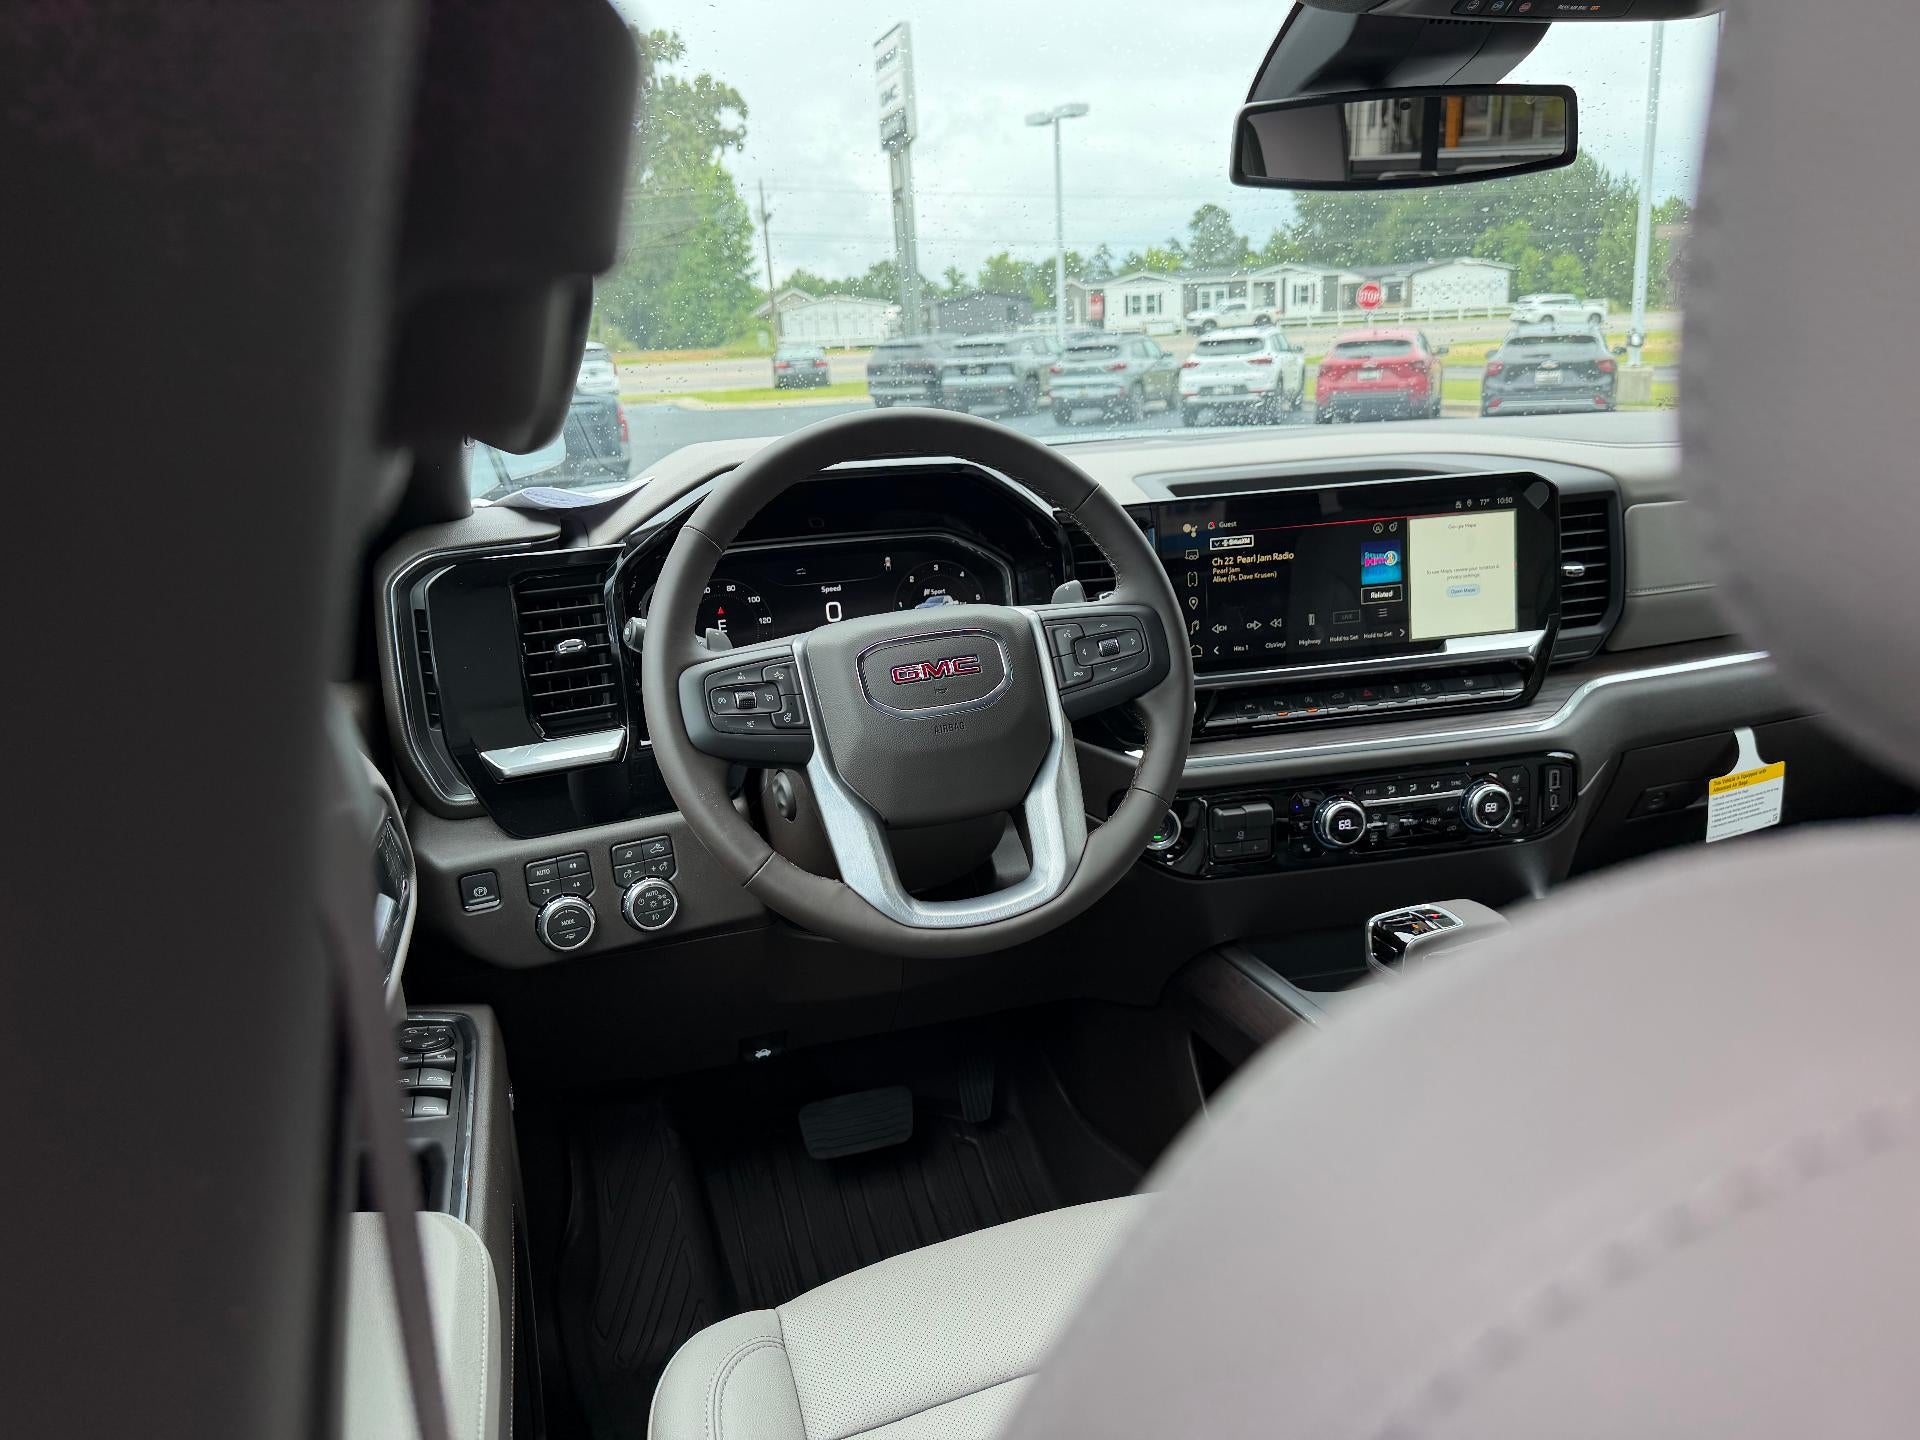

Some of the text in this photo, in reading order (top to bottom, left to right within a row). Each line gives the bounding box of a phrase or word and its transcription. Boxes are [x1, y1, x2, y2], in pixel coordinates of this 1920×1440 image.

[1359, 290, 1380, 303] STOP
[1211, 552, 1294, 566] Ch 22 Pearl Jam Radio
[959, 570, 965, 578] 4
[1212, 566, 1241, 575] Pearl Jam
[1212, 575, 1228, 583] Alive
[1238, 573, 1254, 581] Dave
[1254, 571, 1278, 580] Krusen)
[726, 584, 736, 592] 80
[820, 584, 842, 594] Speed
[747, 595, 761, 603] 100
[1370, 590, 1394, 599] Related
[825, 601, 843, 623] 0
[758, 616, 772, 624] 120
[890, 654, 982, 685] GMC
[933, 721, 966, 735] AIRBAG
[536, 868, 551, 876] AUTO
[645, 889, 659, 898] AUTO
